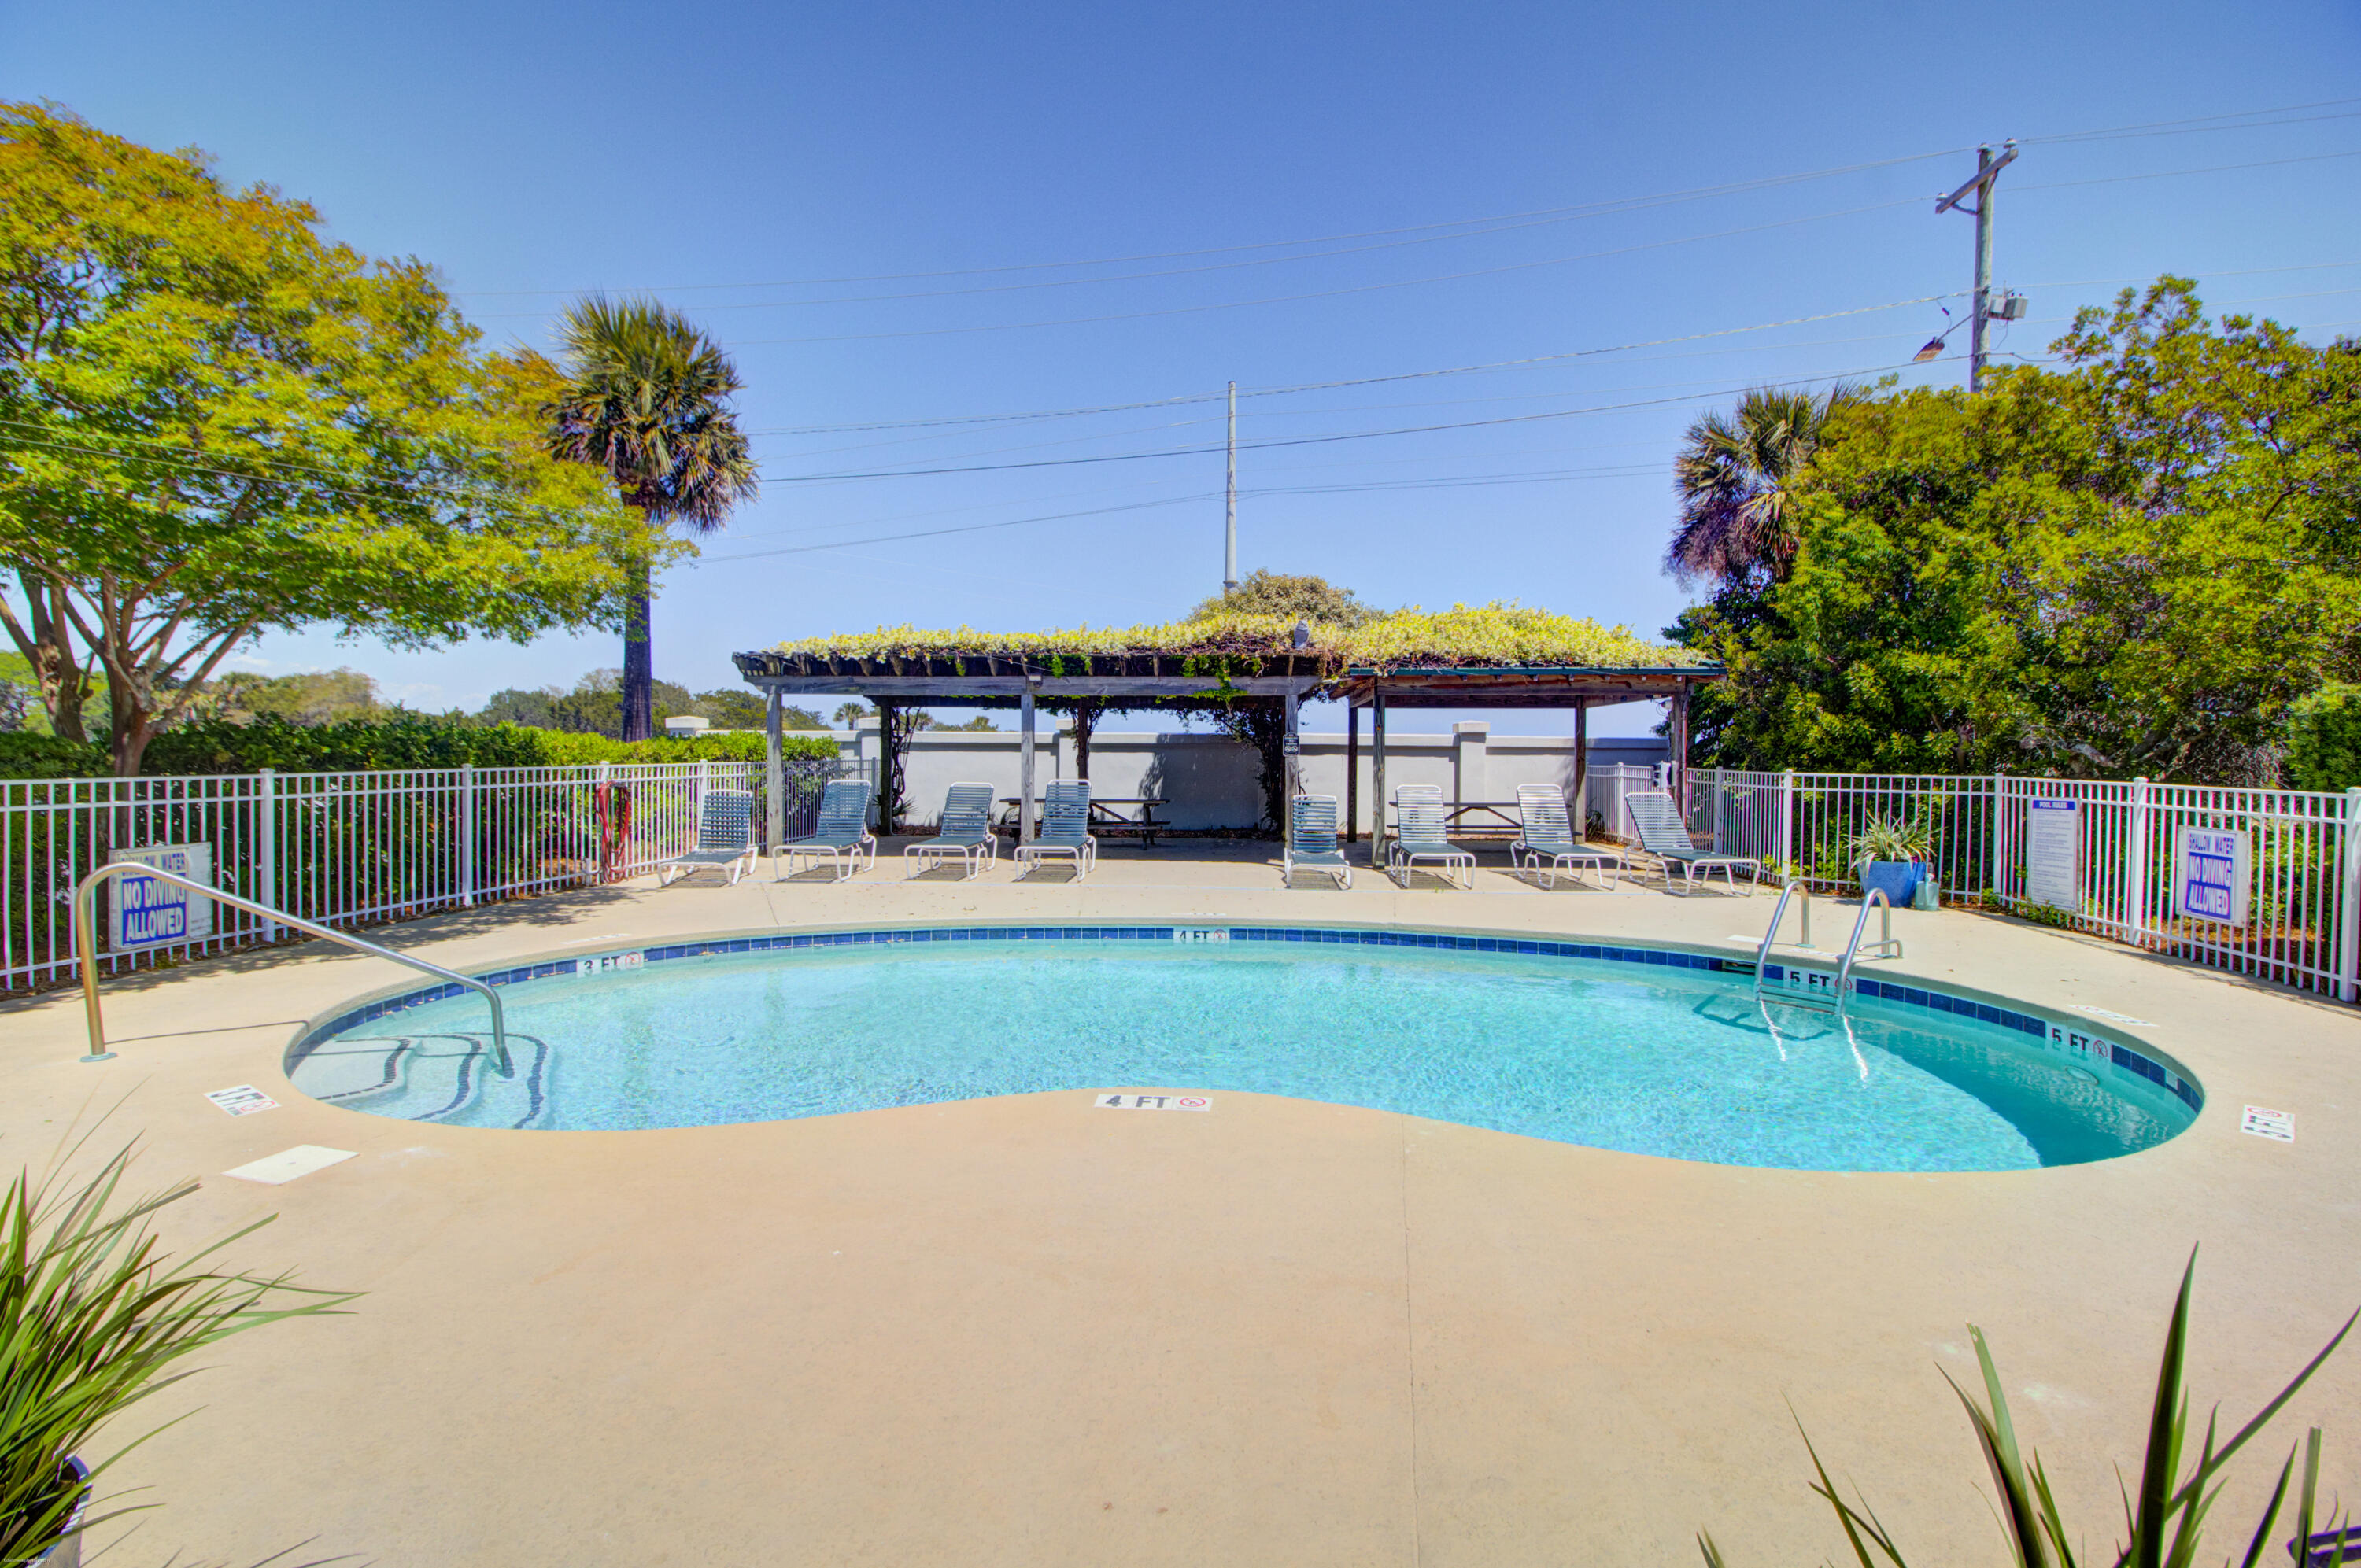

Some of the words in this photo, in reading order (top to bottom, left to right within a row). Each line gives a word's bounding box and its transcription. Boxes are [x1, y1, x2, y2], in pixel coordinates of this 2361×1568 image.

[2189, 833, 2211, 851] SHALLOW
[2215, 836, 2234, 855] WATER
[161, 852, 186, 871] WATER
[2189, 855, 2201, 881] NO
[2202, 857, 2232, 887] DIVING
[123, 881, 142, 910] NO
[144, 880, 186, 907] DIVING
[2188, 884, 2229, 916] ALLOWED
[126, 906, 184, 941] ALLOWED
[1179, 930, 1186, 939] 4
[1193, 930, 1210, 939] FT
[584, 960, 593, 969] 3
[601, 956, 620, 968] FT
[1790, 971, 1800, 982] 5
[1809, 973, 1830, 987] FT
[2052, 1028, 2061, 1042] 5
[2070, 1033, 2089, 1050] FT
[217, 1092, 266, 1102] FT
[1105, 1095, 1122, 1107] 4
[1135, 1096, 1172, 1108] FT
[2248, 1115, 2286, 1131] FT
